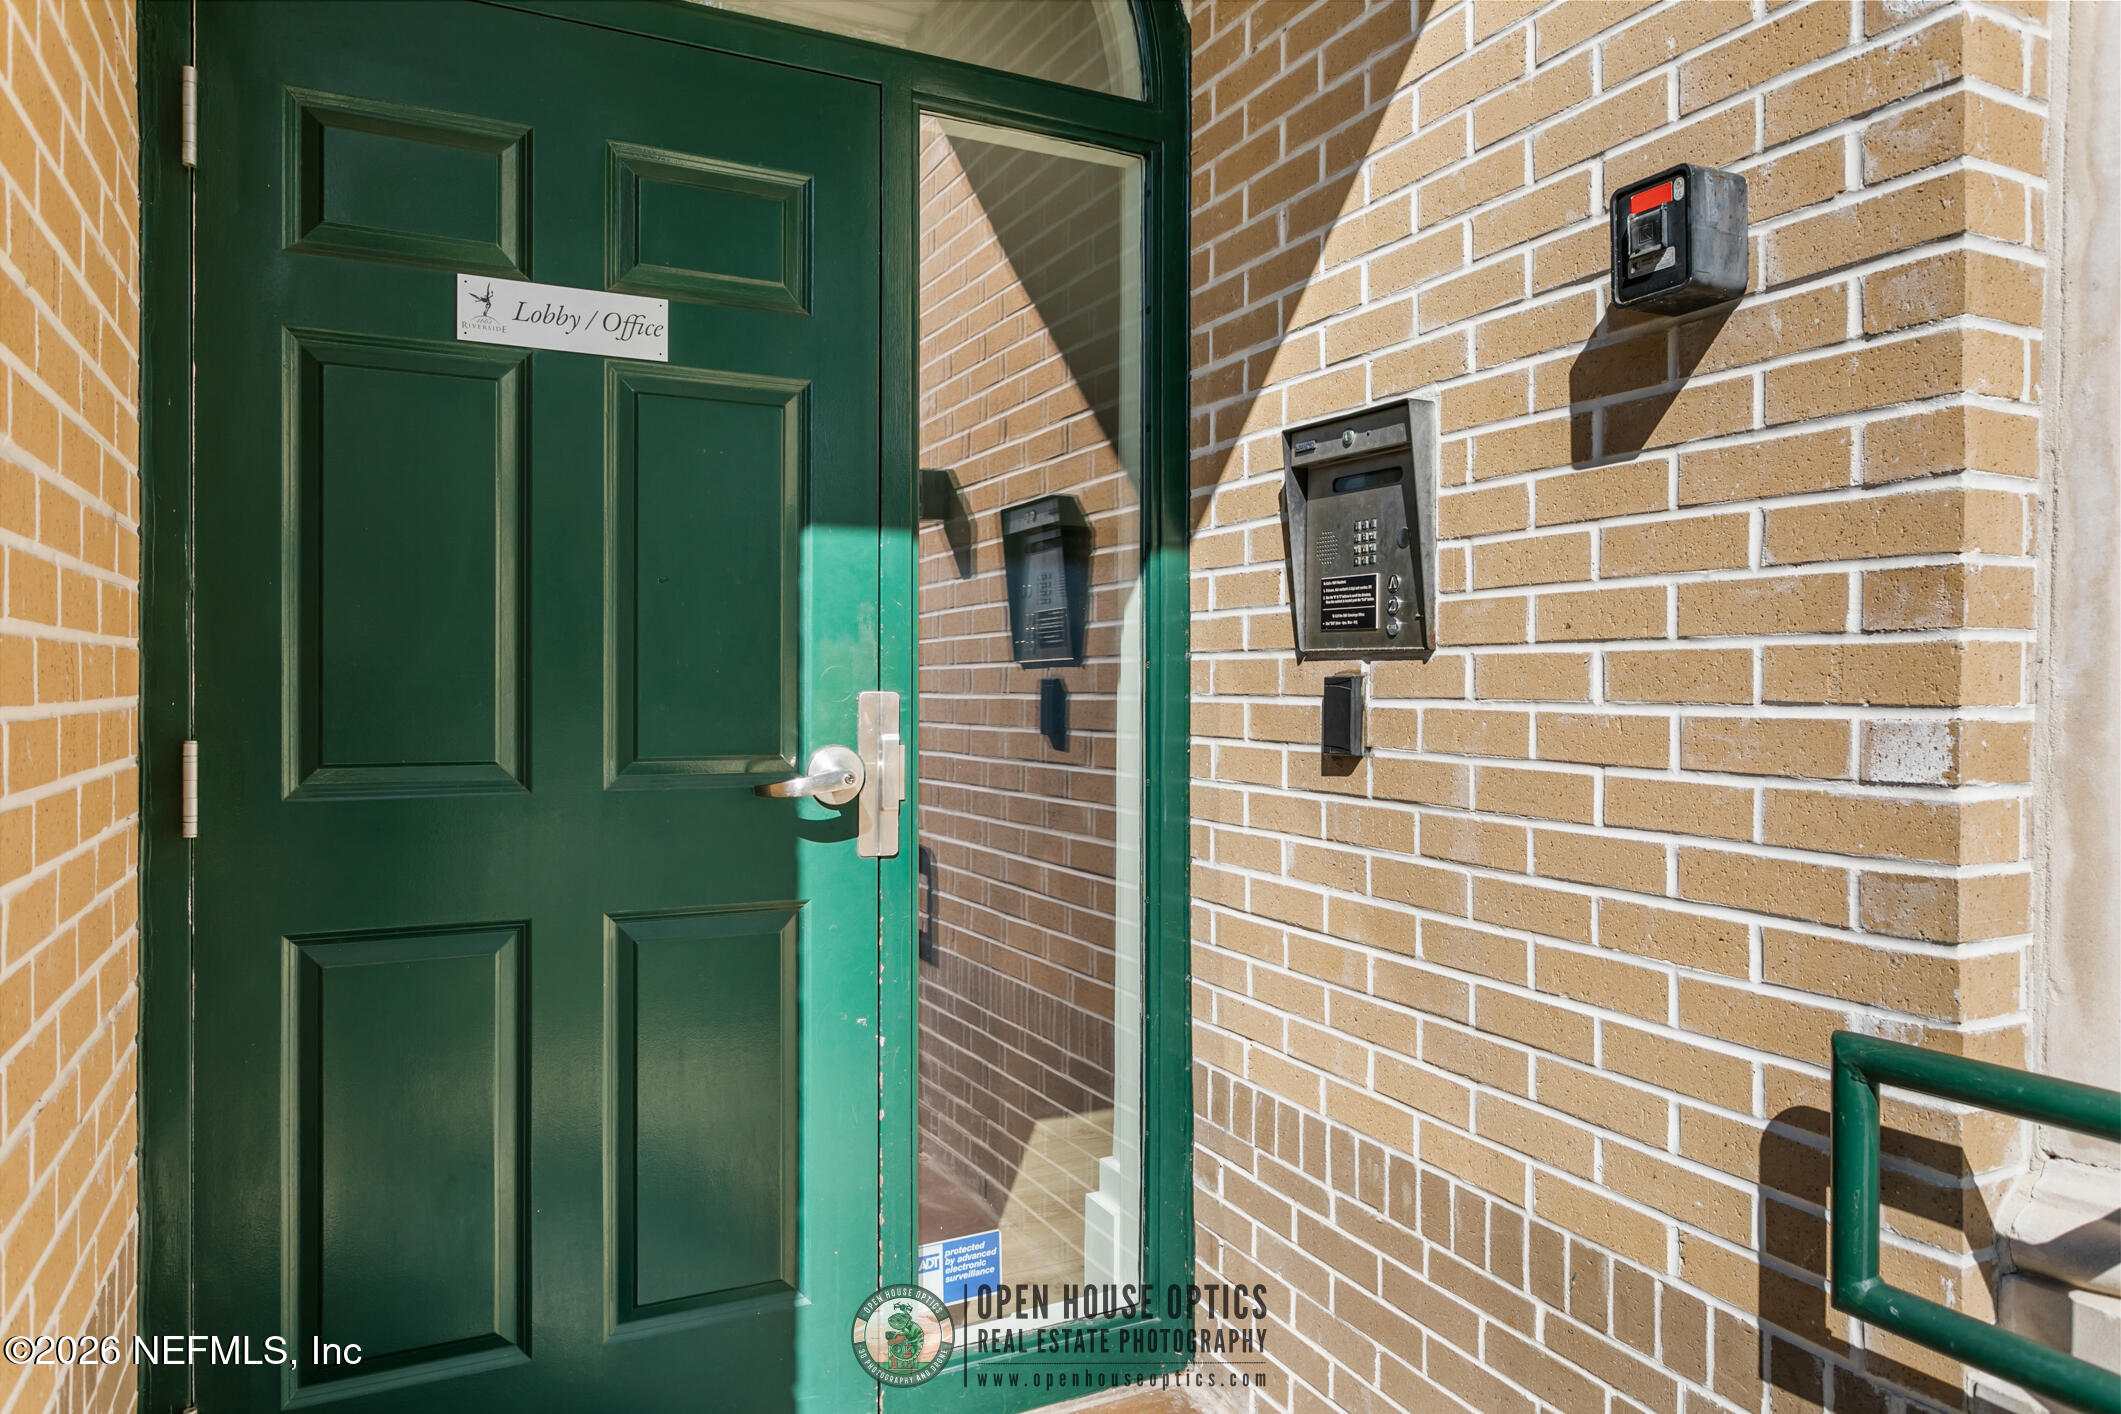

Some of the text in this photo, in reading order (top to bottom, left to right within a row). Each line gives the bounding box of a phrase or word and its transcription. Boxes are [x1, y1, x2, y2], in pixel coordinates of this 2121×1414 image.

[512, 300, 664, 341] Lobby / Office
[944, 1241, 985, 1258] protected
[944, 1247, 997, 1266] by advanced
[918, 1256, 939, 1272] ADT
[945, 1259, 987, 1275] electronic
[945, 1266, 995, 1283] surveillance
